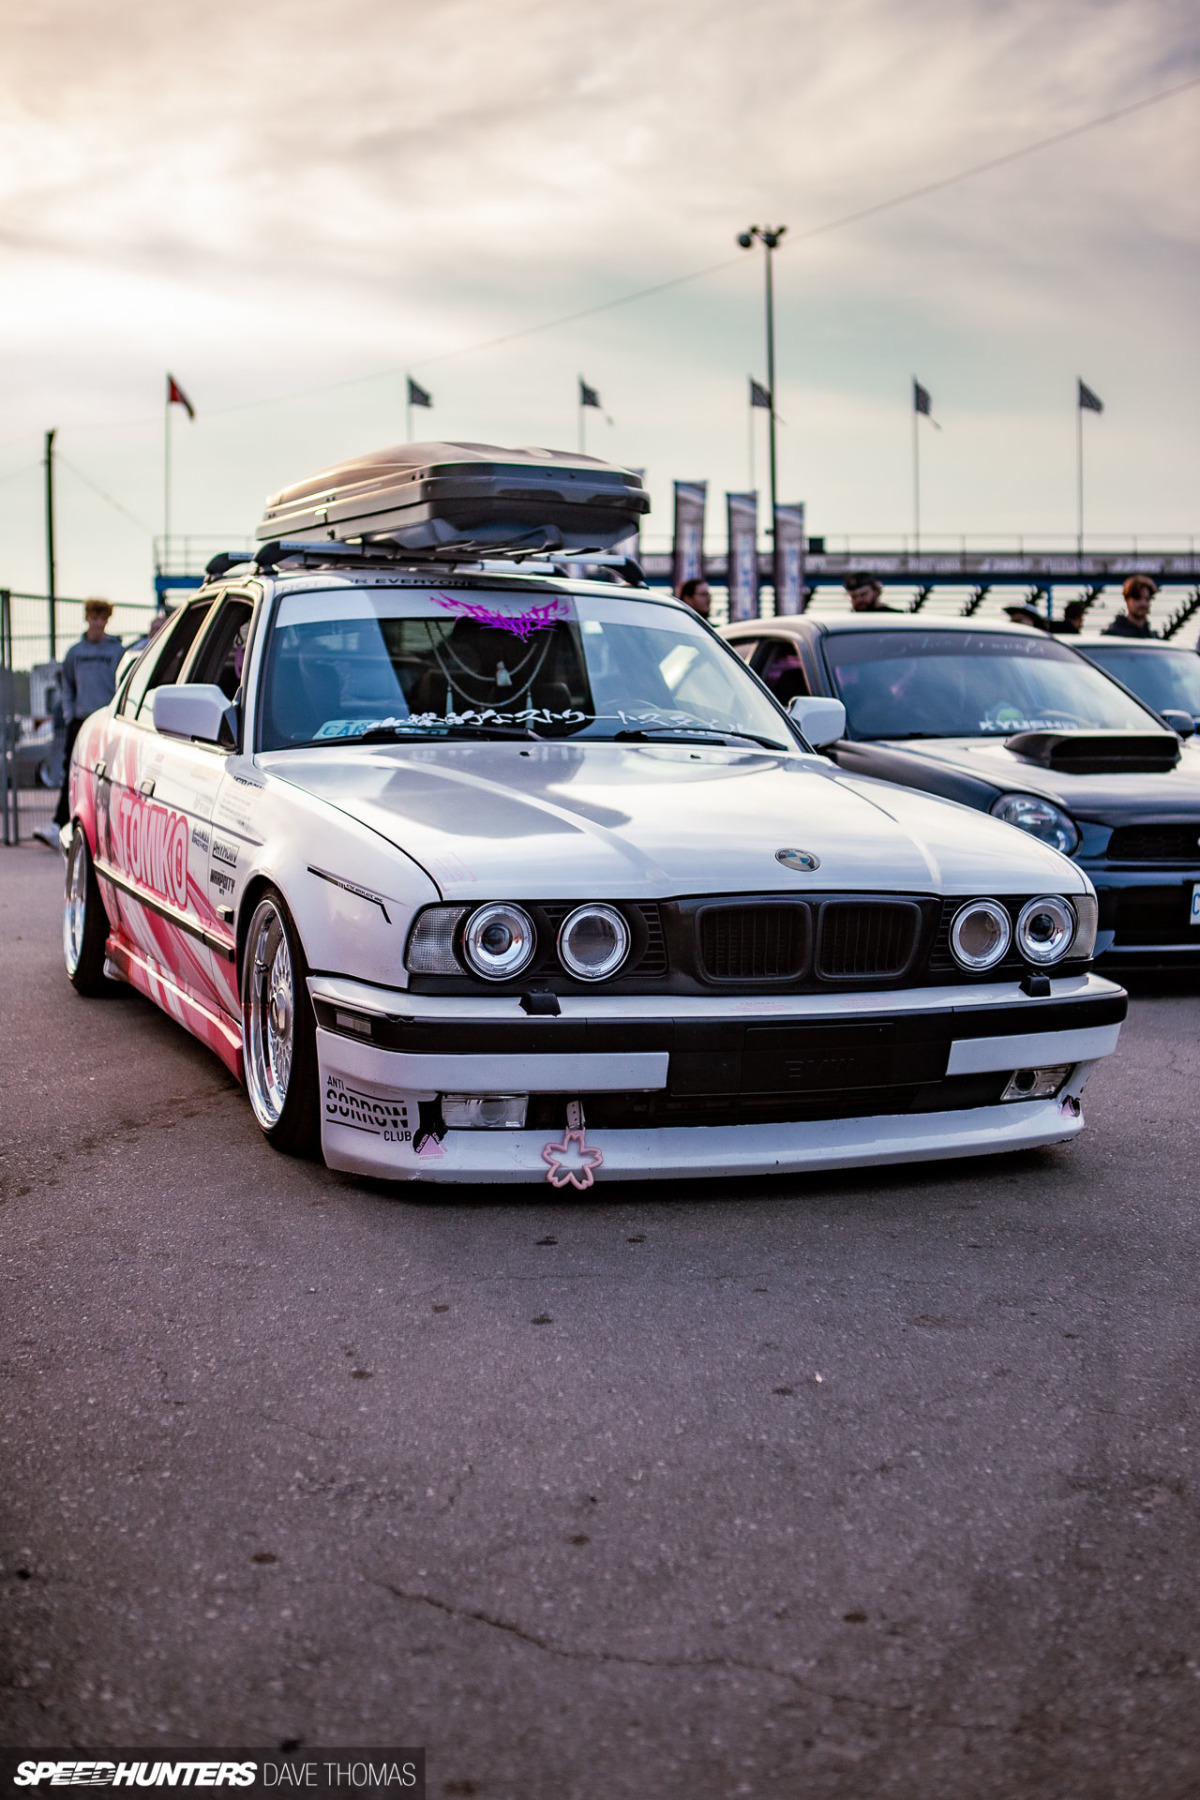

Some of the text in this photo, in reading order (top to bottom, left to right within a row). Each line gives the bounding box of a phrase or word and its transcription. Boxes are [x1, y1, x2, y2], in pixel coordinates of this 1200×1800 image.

[328, 1075, 345, 1091] ANTI
[326, 1089, 408, 1128] SORROW
[384, 1131, 412, 1142] CLUB
